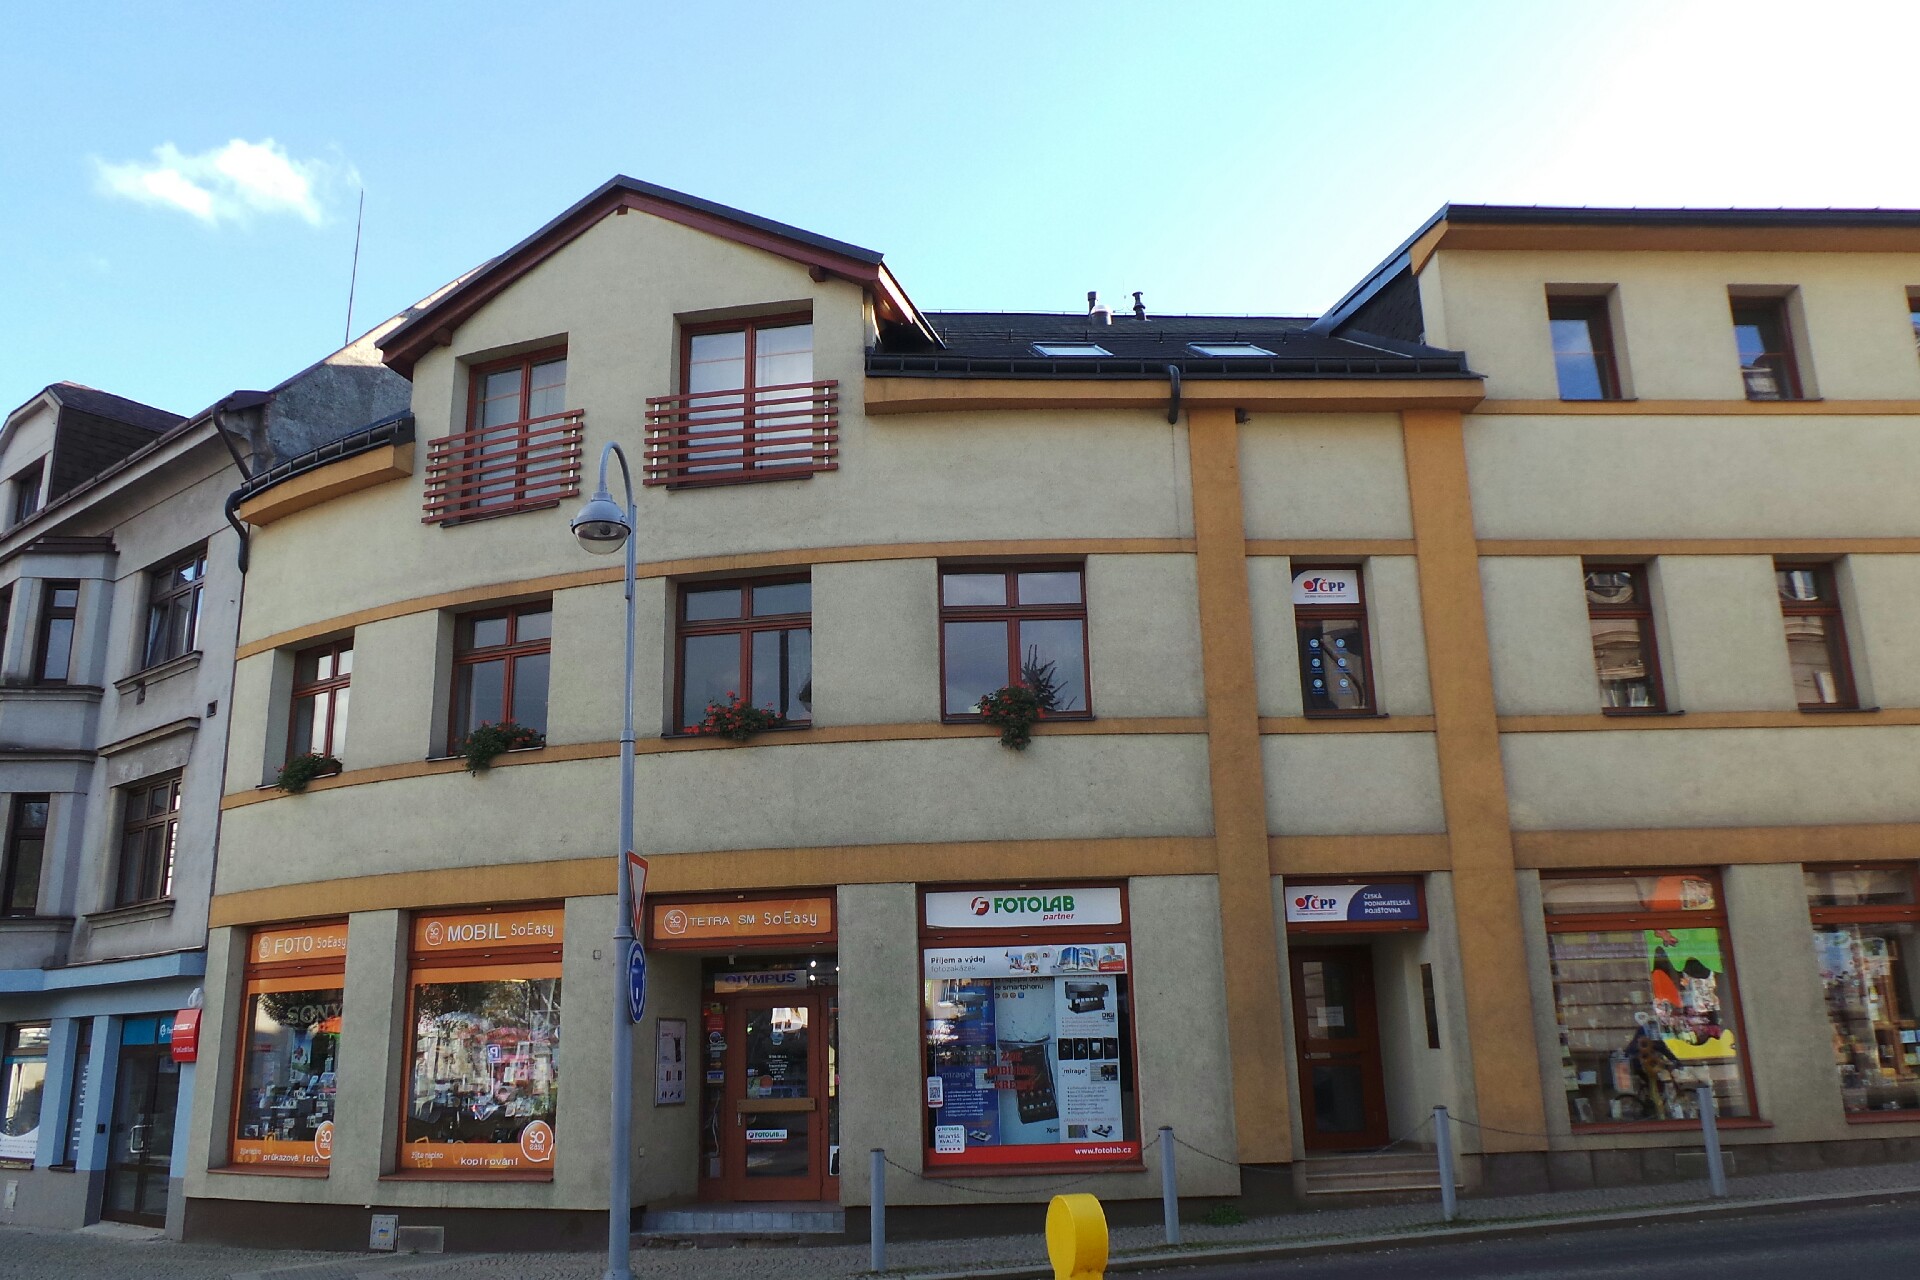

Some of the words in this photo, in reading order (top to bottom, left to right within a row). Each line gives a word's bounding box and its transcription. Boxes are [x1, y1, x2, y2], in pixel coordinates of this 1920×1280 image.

[1319, 579, 1346, 592] ČPP
[994, 895, 1075, 913] FOTOLAB
[1311, 896, 1337, 910] ČPP
[689, 916, 731, 927] TETRA
[737, 914, 756, 925] SM
[763, 911, 818, 927] SoEasy
[1042, 913, 1075, 921] partner
[447, 922, 507, 942] MOBIL
[510, 922, 555, 937] SoEasy
[274, 935, 313, 955] FOTO
[316, 935, 347, 950] SoEasy
[930, 955, 956, 964] Příjem
[964, 955, 986, 964] výdej
[930, 965, 976, 973] fotozakázek
[724, 973, 797, 985] OLYMPUS
[1074, 1146, 1132, 1155] www.fotolab.cz
[302, 1154, 319, 1163] foto
[460, 1157, 519, 1166] kopírování
